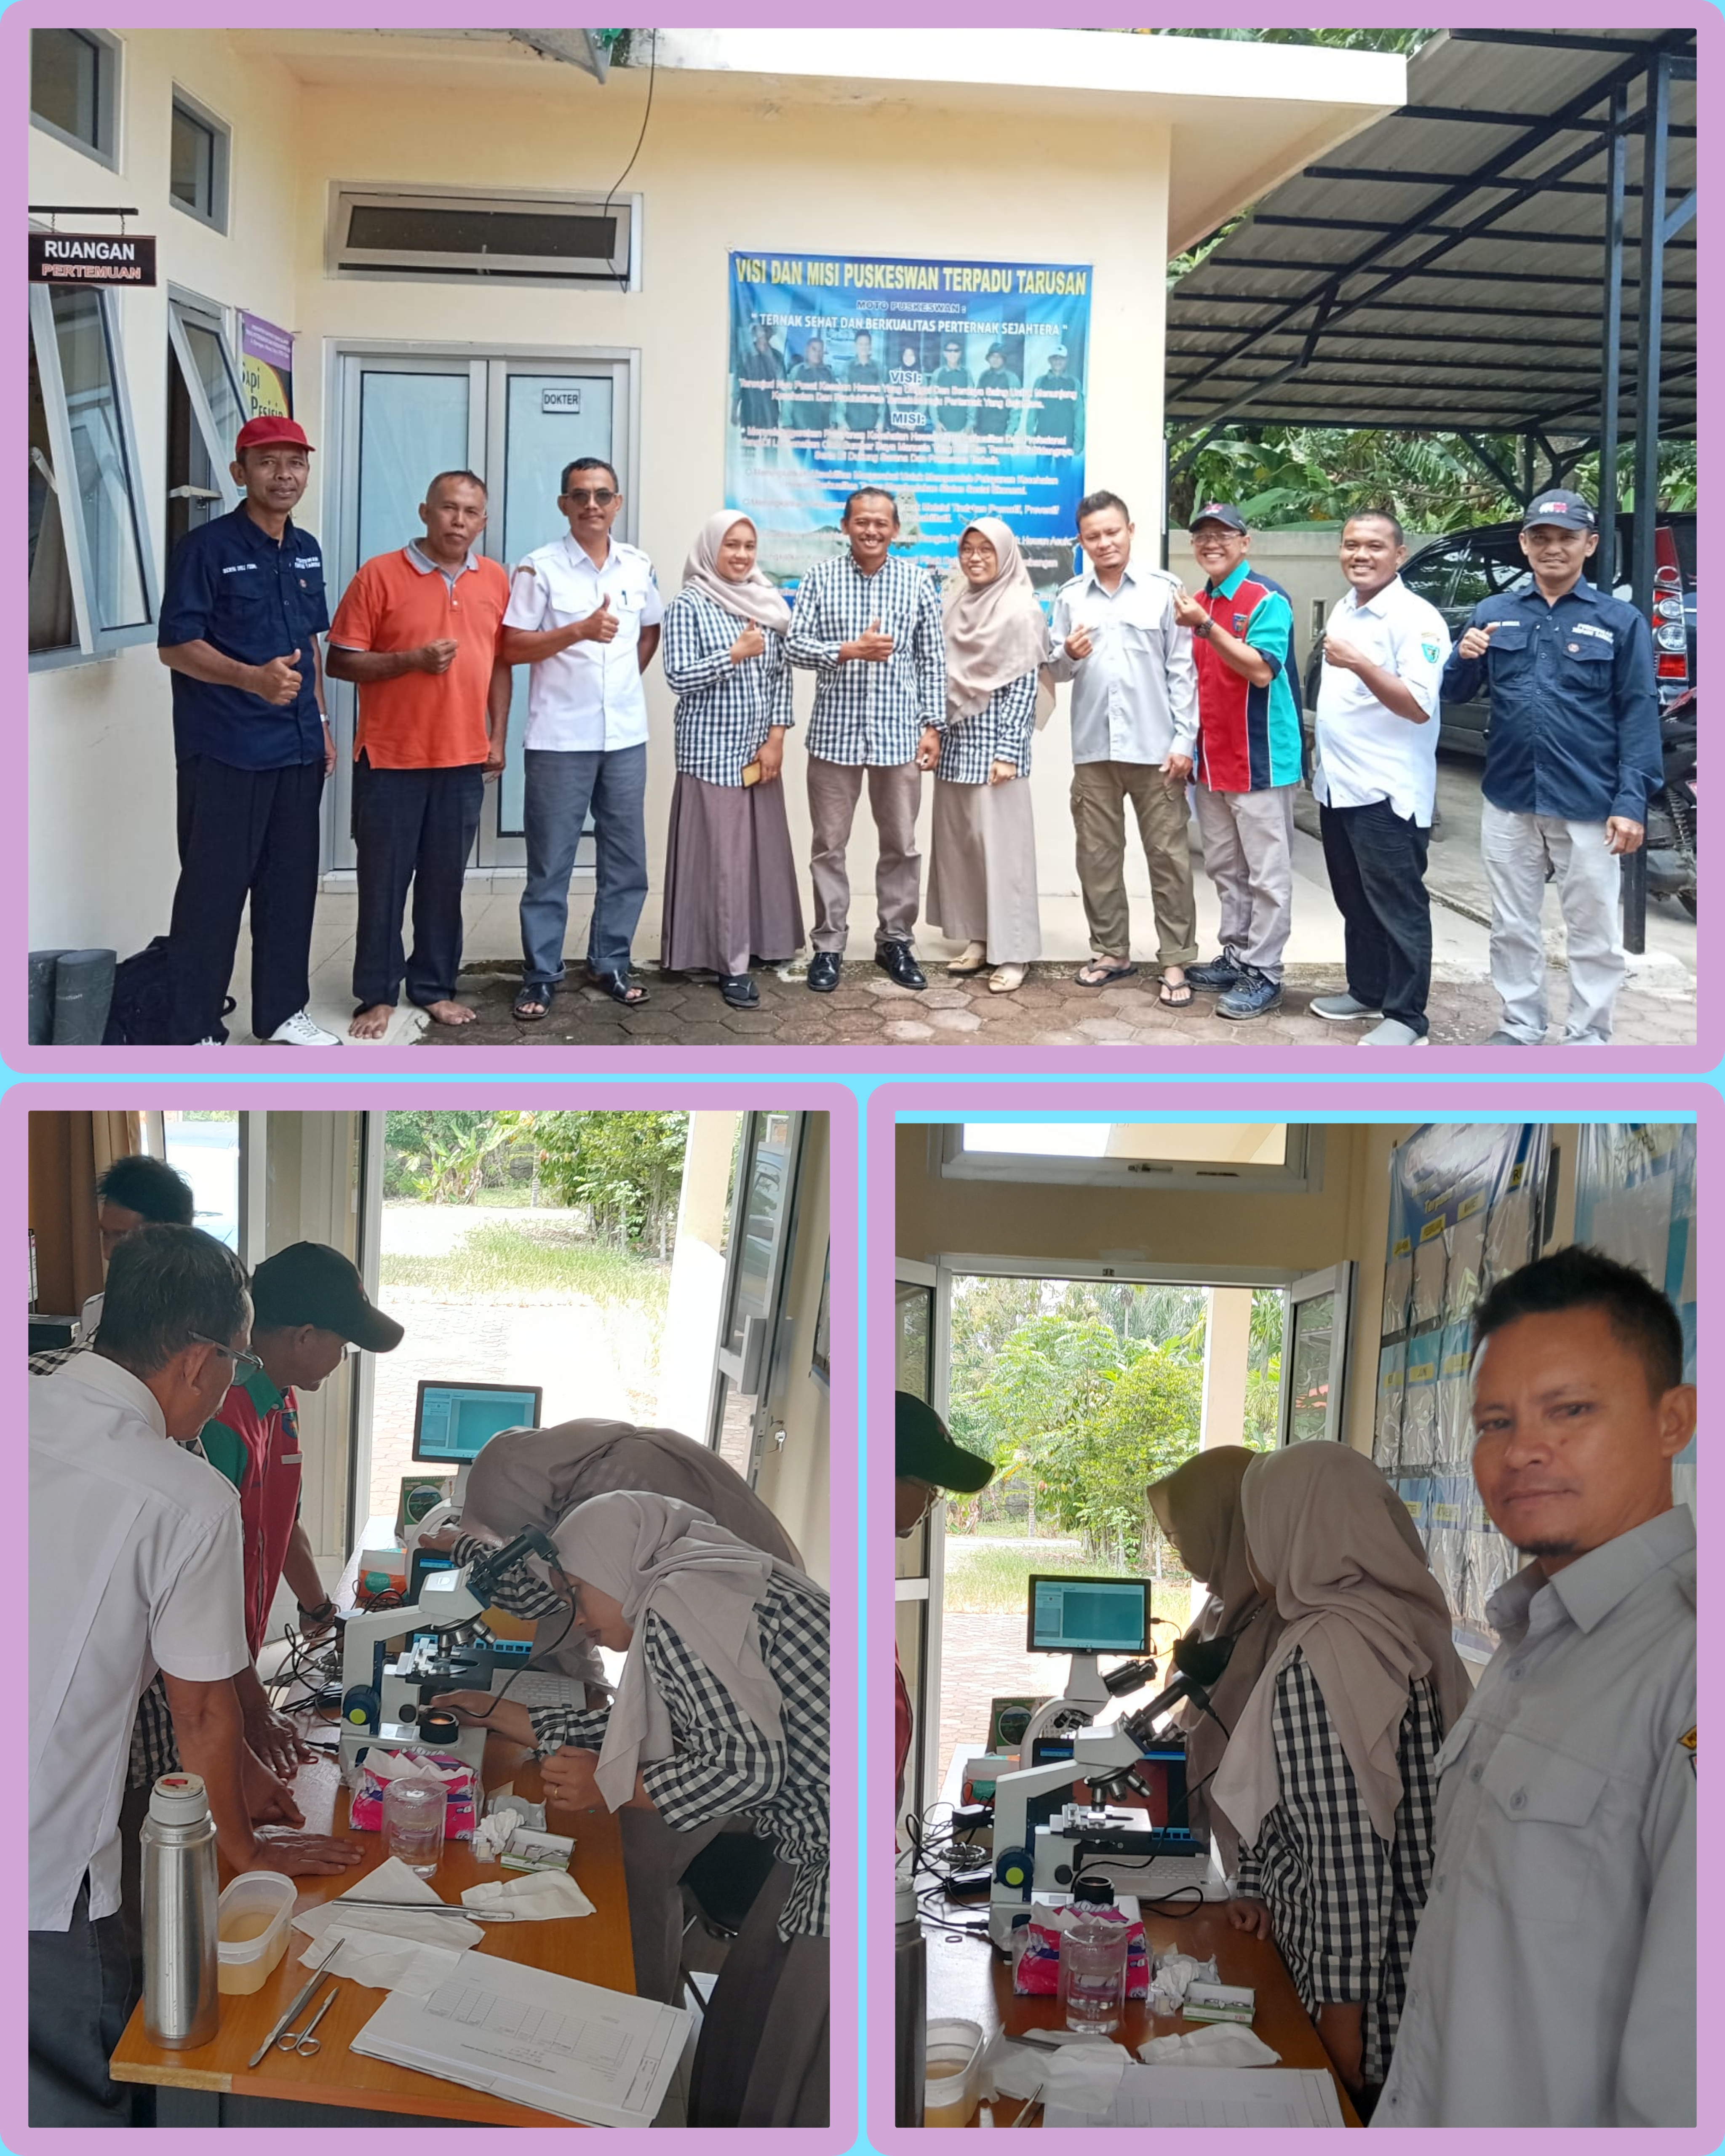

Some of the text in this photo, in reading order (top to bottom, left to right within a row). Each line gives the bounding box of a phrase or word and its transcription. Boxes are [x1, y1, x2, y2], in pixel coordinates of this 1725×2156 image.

[45, 240, 135, 260] RUANGAN
[42, 264, 141, 279] PERTEMUAN
[736, 258, 1087, 295] VISI DAN MISI PUSKESWAN TERPADU TARUSAN
[857, 300, 888, 310] MOTO
[890, 301, 960, 313] PUSKESWAN
[760, 313, 802, 327] TERNAK
[804, 316, 838, 328] SEHAT
[841, 317, 864, 329] DAN
[865, 318, 936, 332] BERKUALITAS
[938, 320, 999, 334] PERTERNAK
[1001, 323, 1059, 336] SEJAHTERA
[889, 371, 922, 384] VISI:
[544, 394, 578, 405] DOKTER
[892, 412, 925, 425] MISI:
